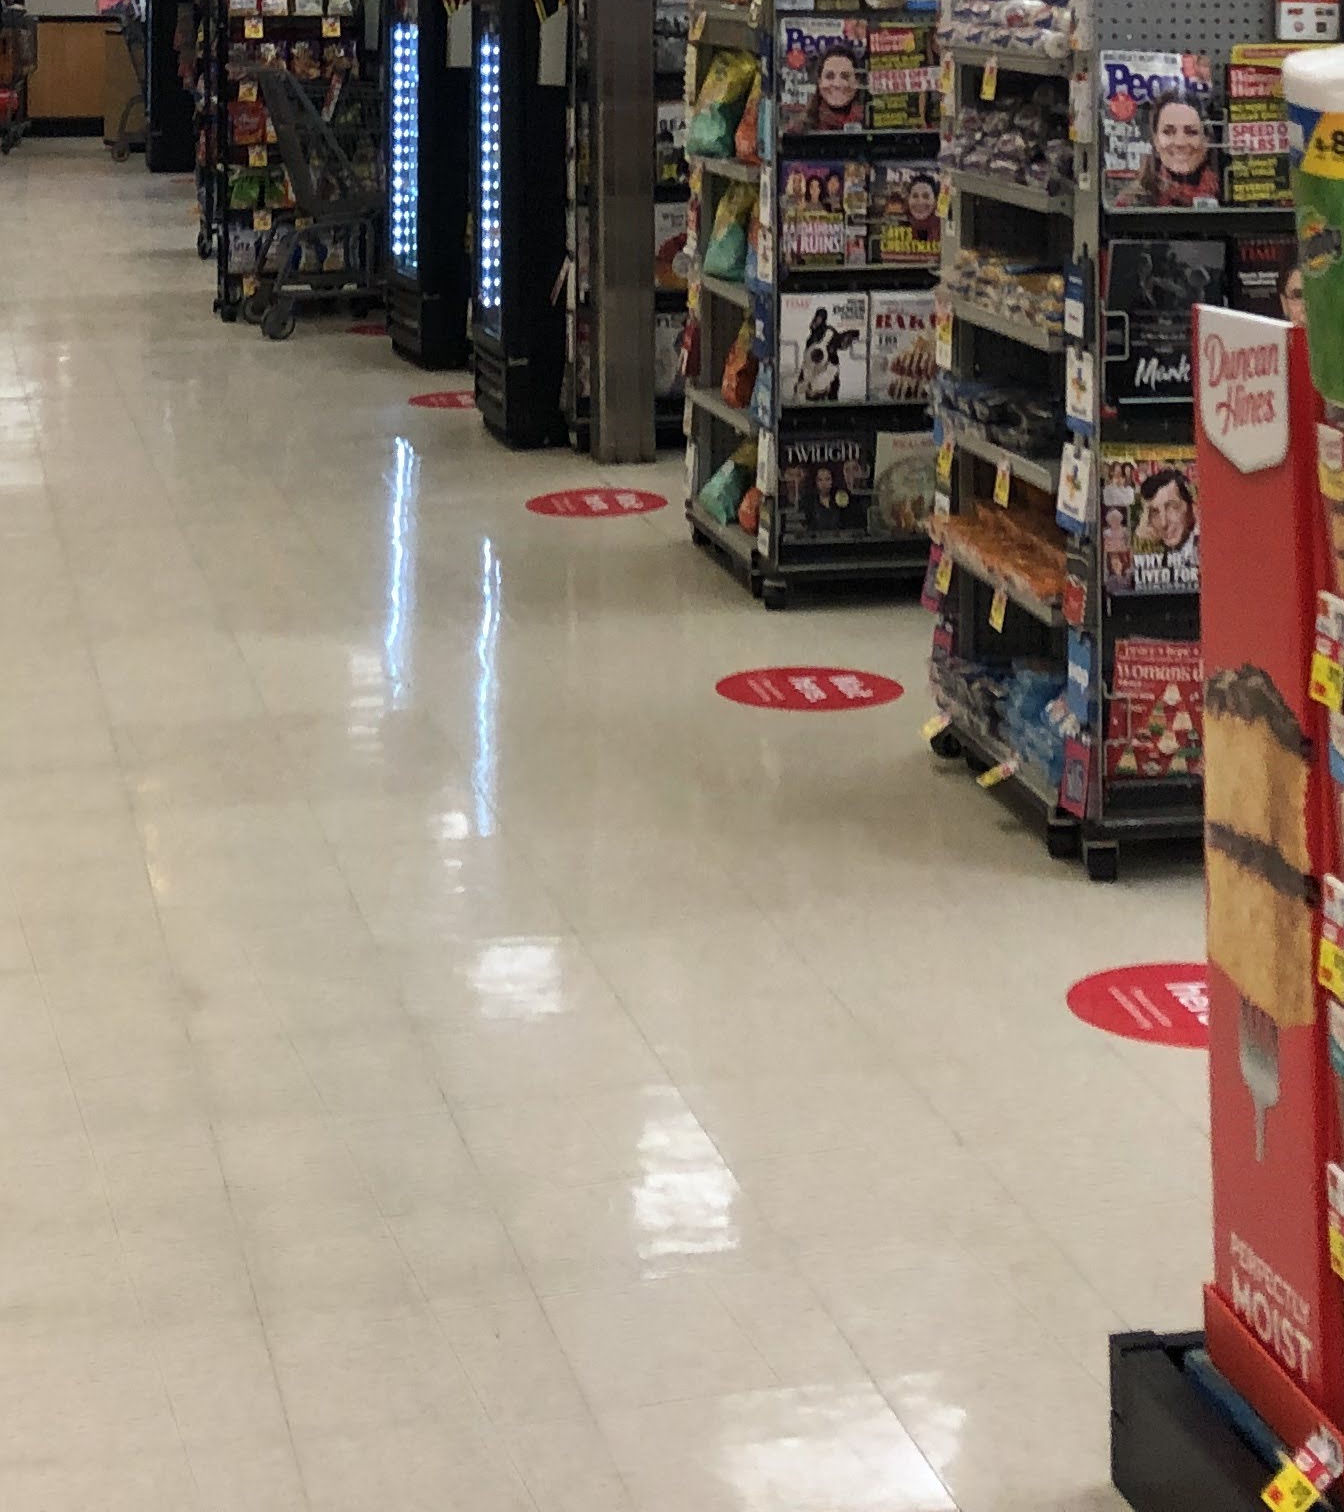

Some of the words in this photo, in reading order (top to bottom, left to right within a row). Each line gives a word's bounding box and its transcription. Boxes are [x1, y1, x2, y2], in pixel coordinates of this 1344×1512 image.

[1204, 333, 1279, 388] Duncan
[1215, 384, 1276, 437] Hines
[785, 440, 861, 464] TWILIGHT
[1230, 1231, 1311, 1325] PERFECTLY
[1231, 1265, 1313, 1383] MOIST
